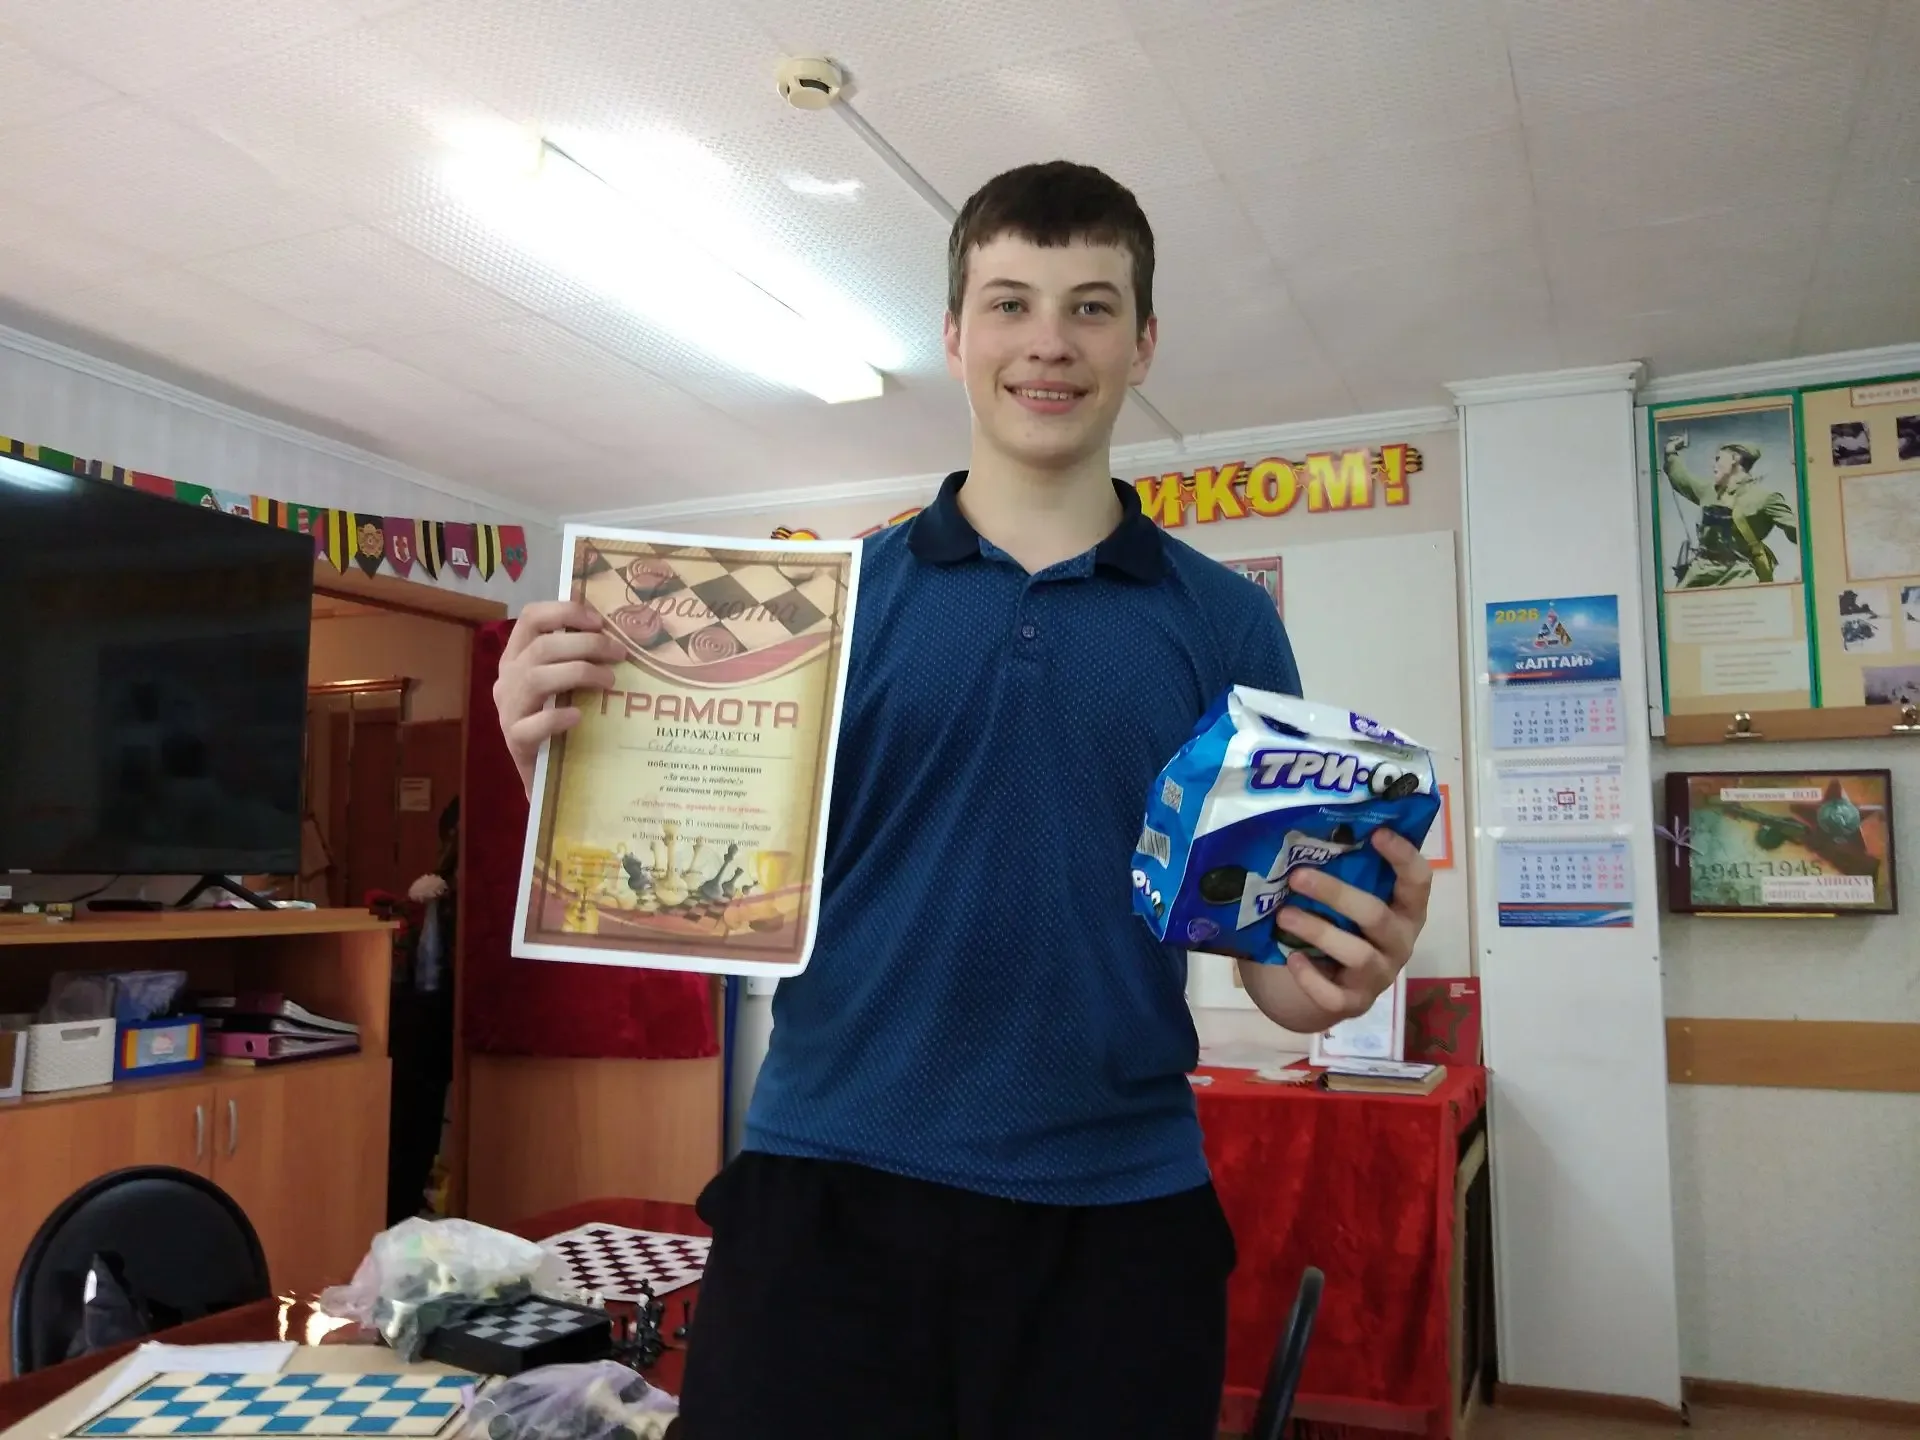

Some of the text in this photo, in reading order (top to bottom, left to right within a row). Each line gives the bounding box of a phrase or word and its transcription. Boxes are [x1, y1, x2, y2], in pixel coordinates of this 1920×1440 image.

[1495, 607, 1539, 624] 2026
[600, 689, 800, 728] ГРАМОТА
[656, 727, 761, 742] НАГРАЖДАЕТСЯ
[647, 760, 701, 772] победитель
[711, 765, 762, 775] номинации
[713, 789, 748, 799] турнире
[685, 817, 694, 827] 81
[741, 821, 772, 832] Победы
